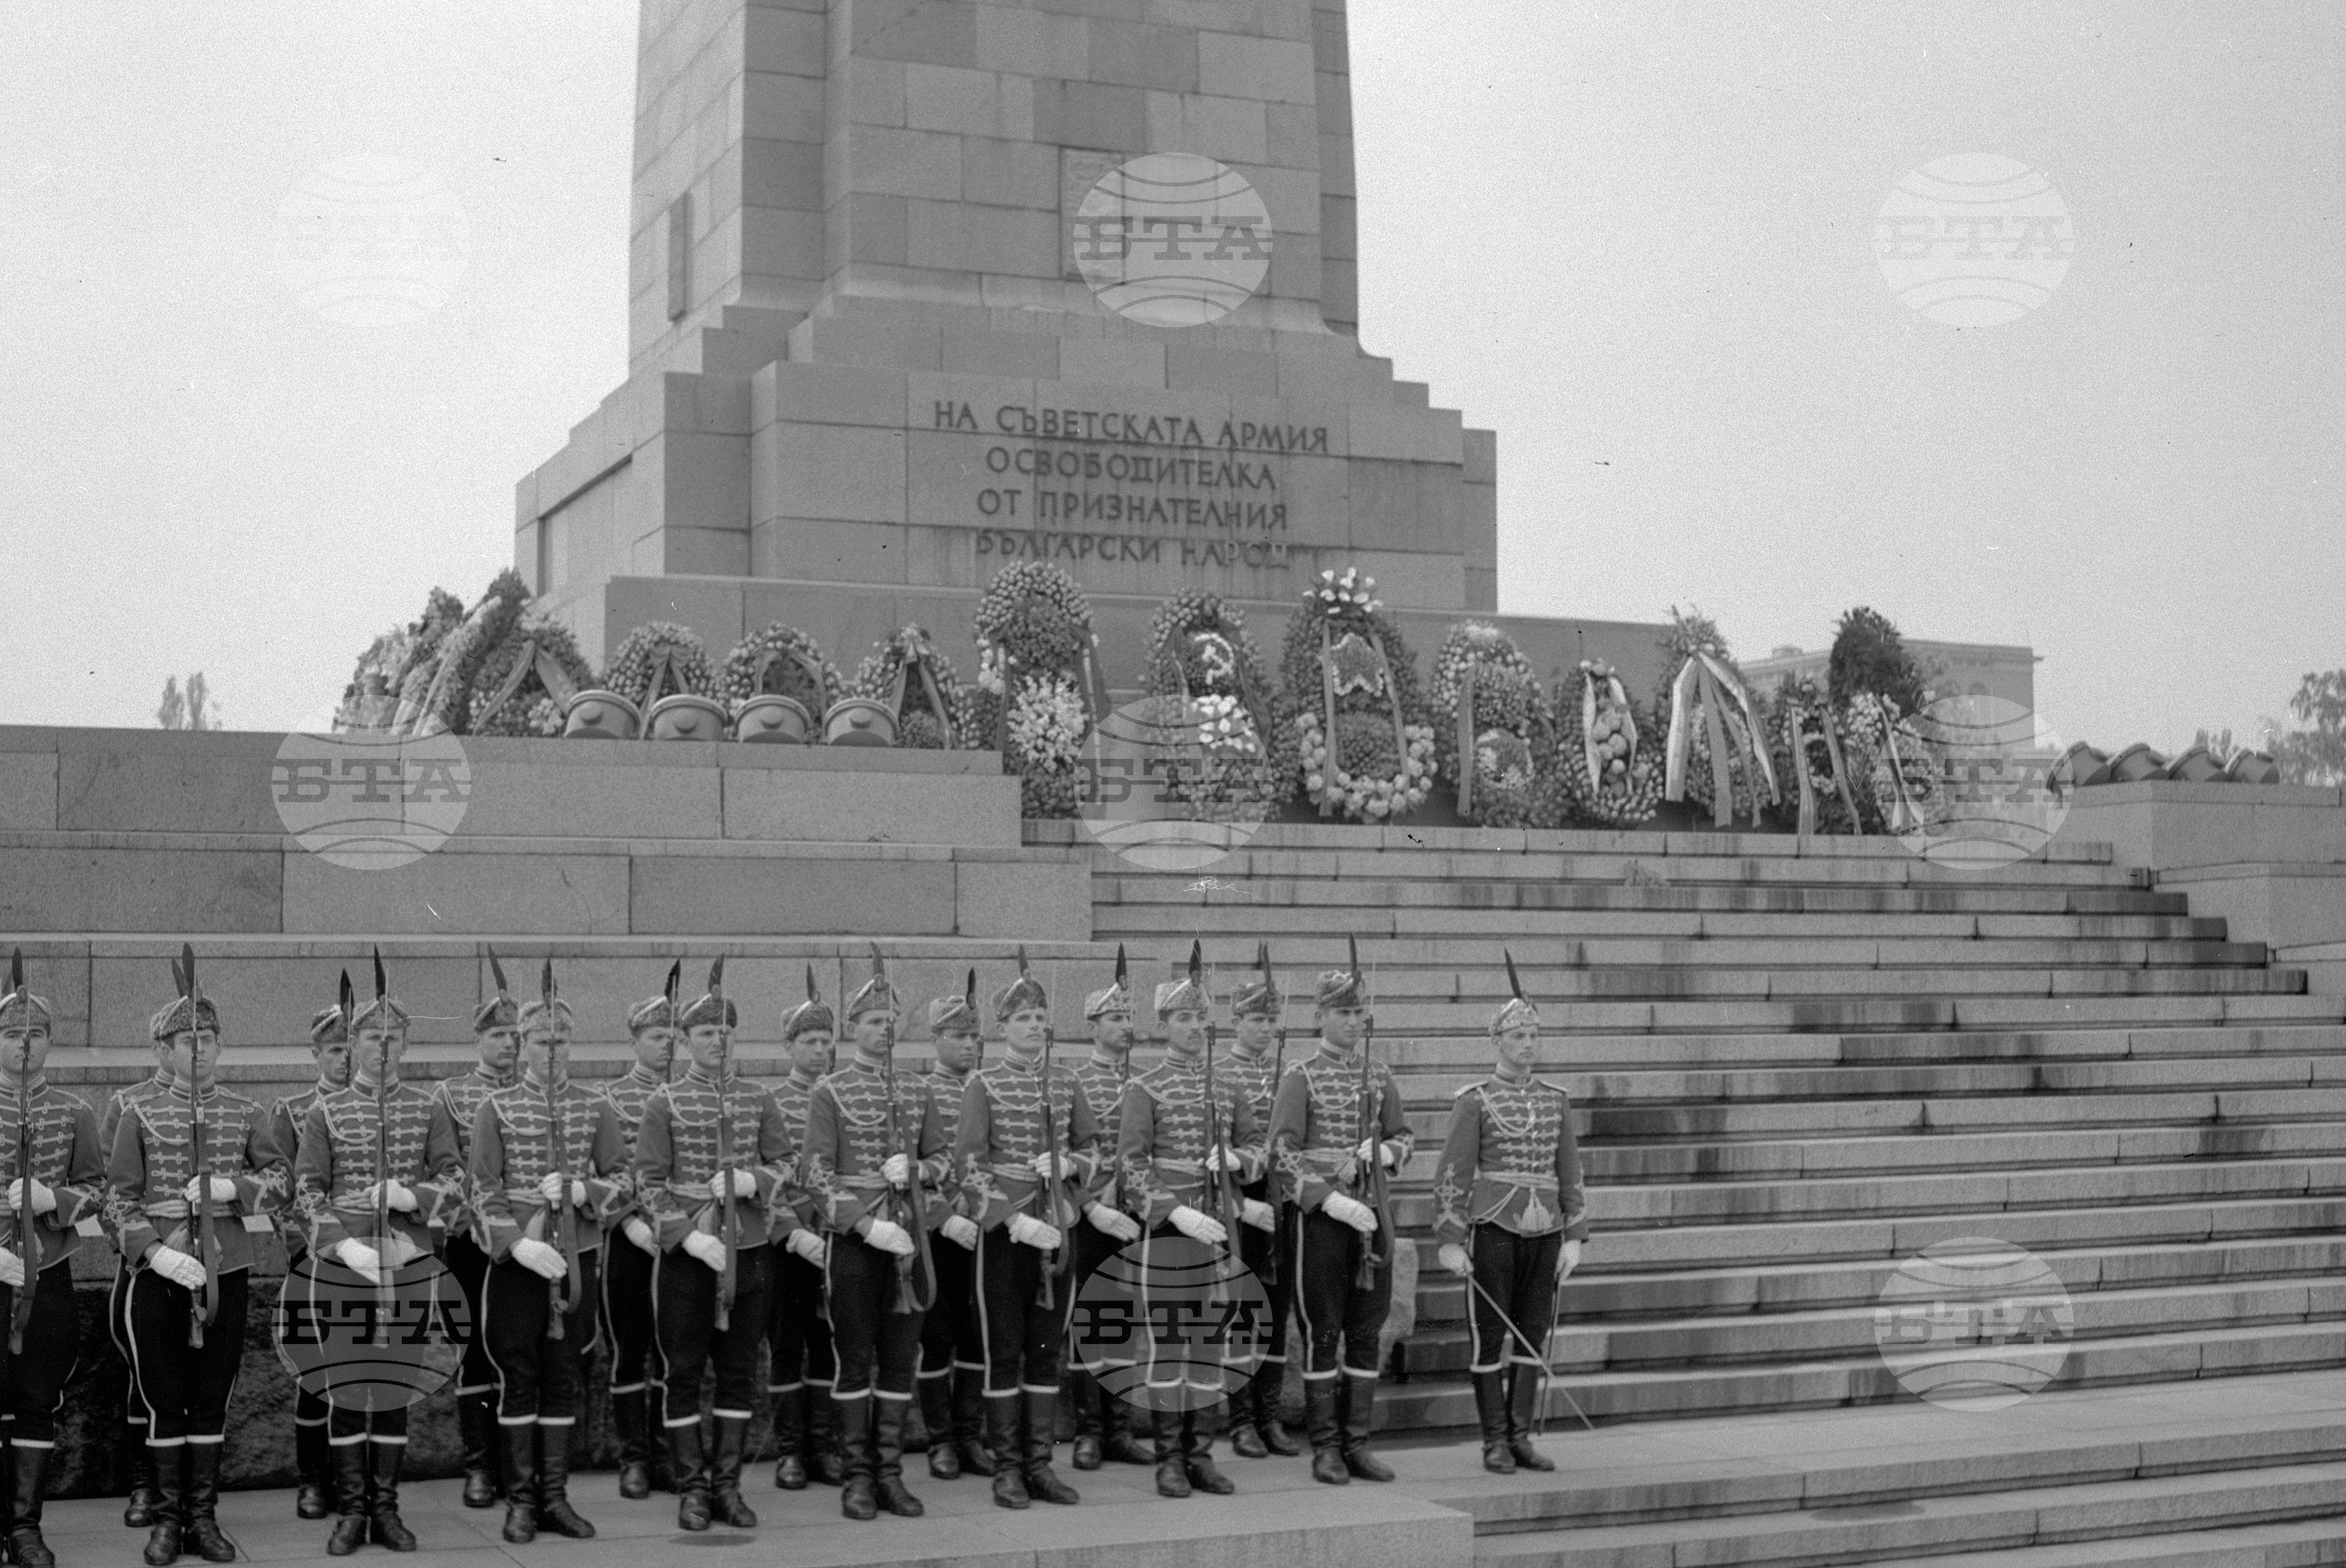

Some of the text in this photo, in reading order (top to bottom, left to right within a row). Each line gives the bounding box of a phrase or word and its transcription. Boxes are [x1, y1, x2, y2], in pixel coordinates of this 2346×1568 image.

[935, 400, 1328, 453] НА СЪВЕТСКАТА АРМИЯ
[986, 446, 1276, 490] ОСВОБОДИТЕЛКА
[977, 489, 1288, 530] ОТ ПРИЗНАТЕЛНИЯ
[976, 529, 1160, 563] БЪЛГАРСКИ
